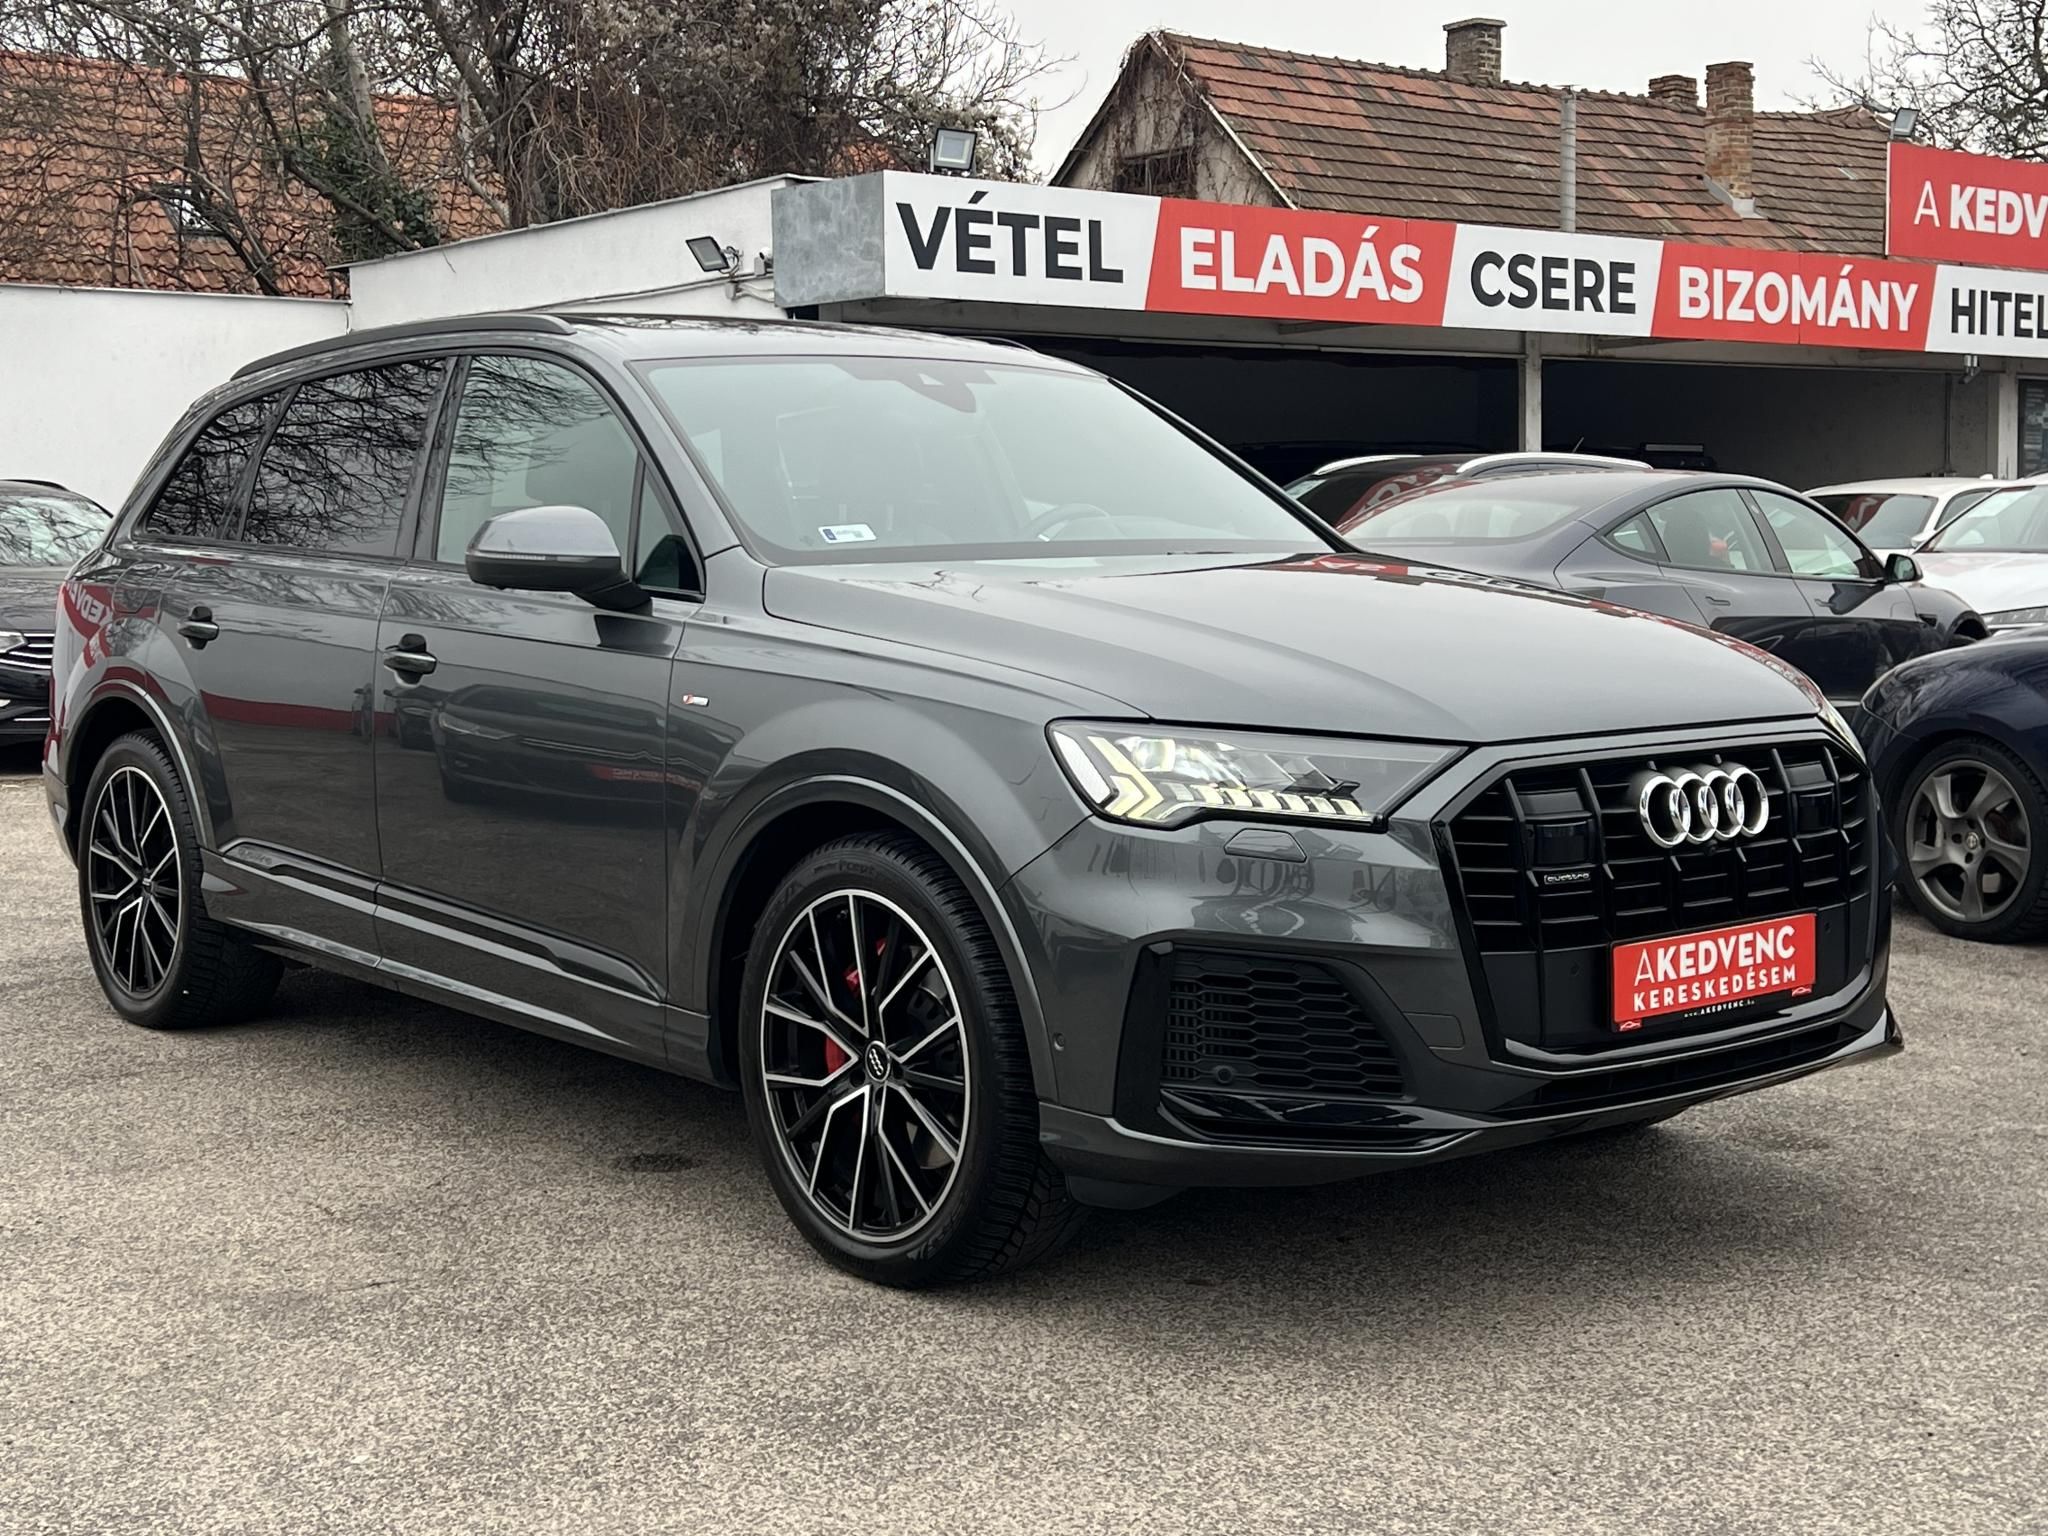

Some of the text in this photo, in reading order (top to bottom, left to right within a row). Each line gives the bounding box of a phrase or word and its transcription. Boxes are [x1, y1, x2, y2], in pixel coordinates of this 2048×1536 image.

[1913, 180, 1941, 227] A
[896, 191, 1124, 284] VÉTEL
[1180, 225, 1425, 304] ELADÁS
[1470, 250, 1637, 315] CSERE
[1678, 264, 1919, 332] BIZOMÁNY
[1633, 963, 1797, 1012] KERESKEDÉSEM
